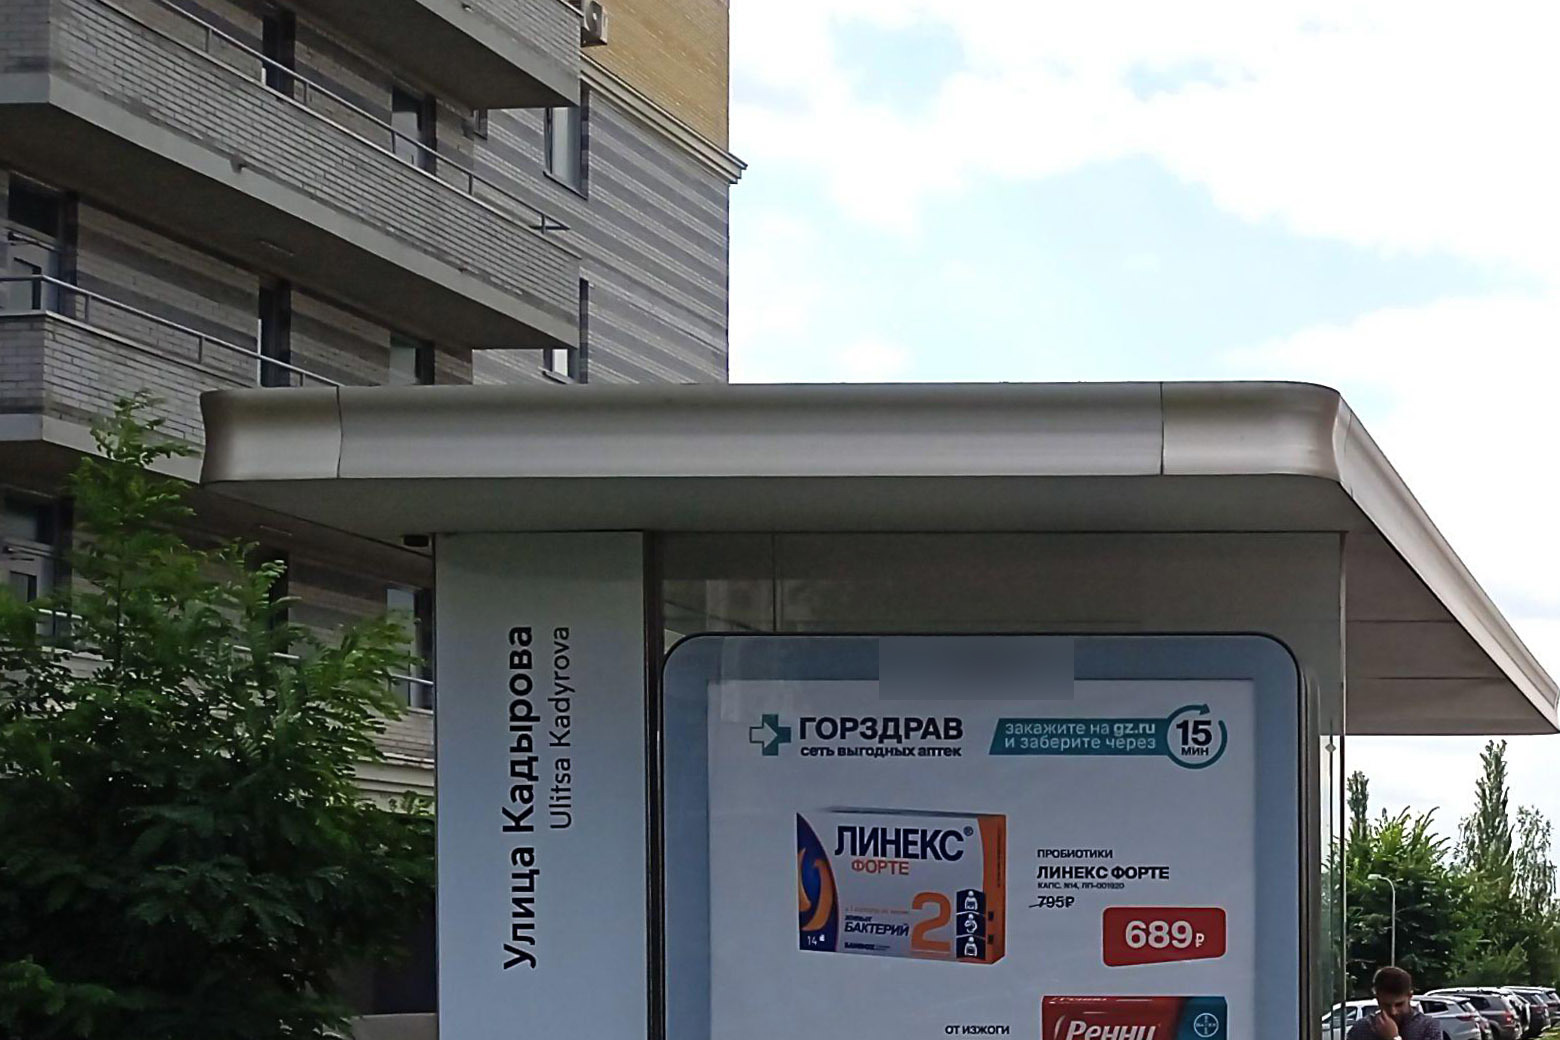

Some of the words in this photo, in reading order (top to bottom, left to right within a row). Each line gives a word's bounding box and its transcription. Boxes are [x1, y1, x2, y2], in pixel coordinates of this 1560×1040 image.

[547, 627, 575, 747] Kadyrova
[502, 626, 540, 833] Кадырова
[800, 717, 963, 744] ГОРЗДРАВ
[1005, 722, 1085, 735] закажите
[1090, 724, 1110, 735] на
[1113, 723, 1156, 737] gz.ru
[1176, 720, 1212, 746] 15
[1004, 738, 1015, 748] и
[1020, 735, 1101, 750] заберите
[1106, 738, 1156, 750] через
[800, 747, 835, 757] сеть
[837, 747, 916, 758] выгодных
[918, 747, 962, 757] аптек
[549, 758, 572, 829] Ulitsa
[1037, 849, 1113, 859] ПРОБИОТИКИ
[851, 858, 910, 875] ФОРТЕ
[1037, 866, 1108, 880] ЛИНЕКС
[1111, 866, 1170, 880] ФОРТЕ
[503, 846, 540, 970] Улица
[844, 921, 910, 936] БАКТЕРИЙ
[911, 891, 953, 951] 2
[807, 935, 818, 946] 14
[944, 1025, 960, 1035] ОТ
[962, 1025, 1010, 1035] ИЗЖОГИ
